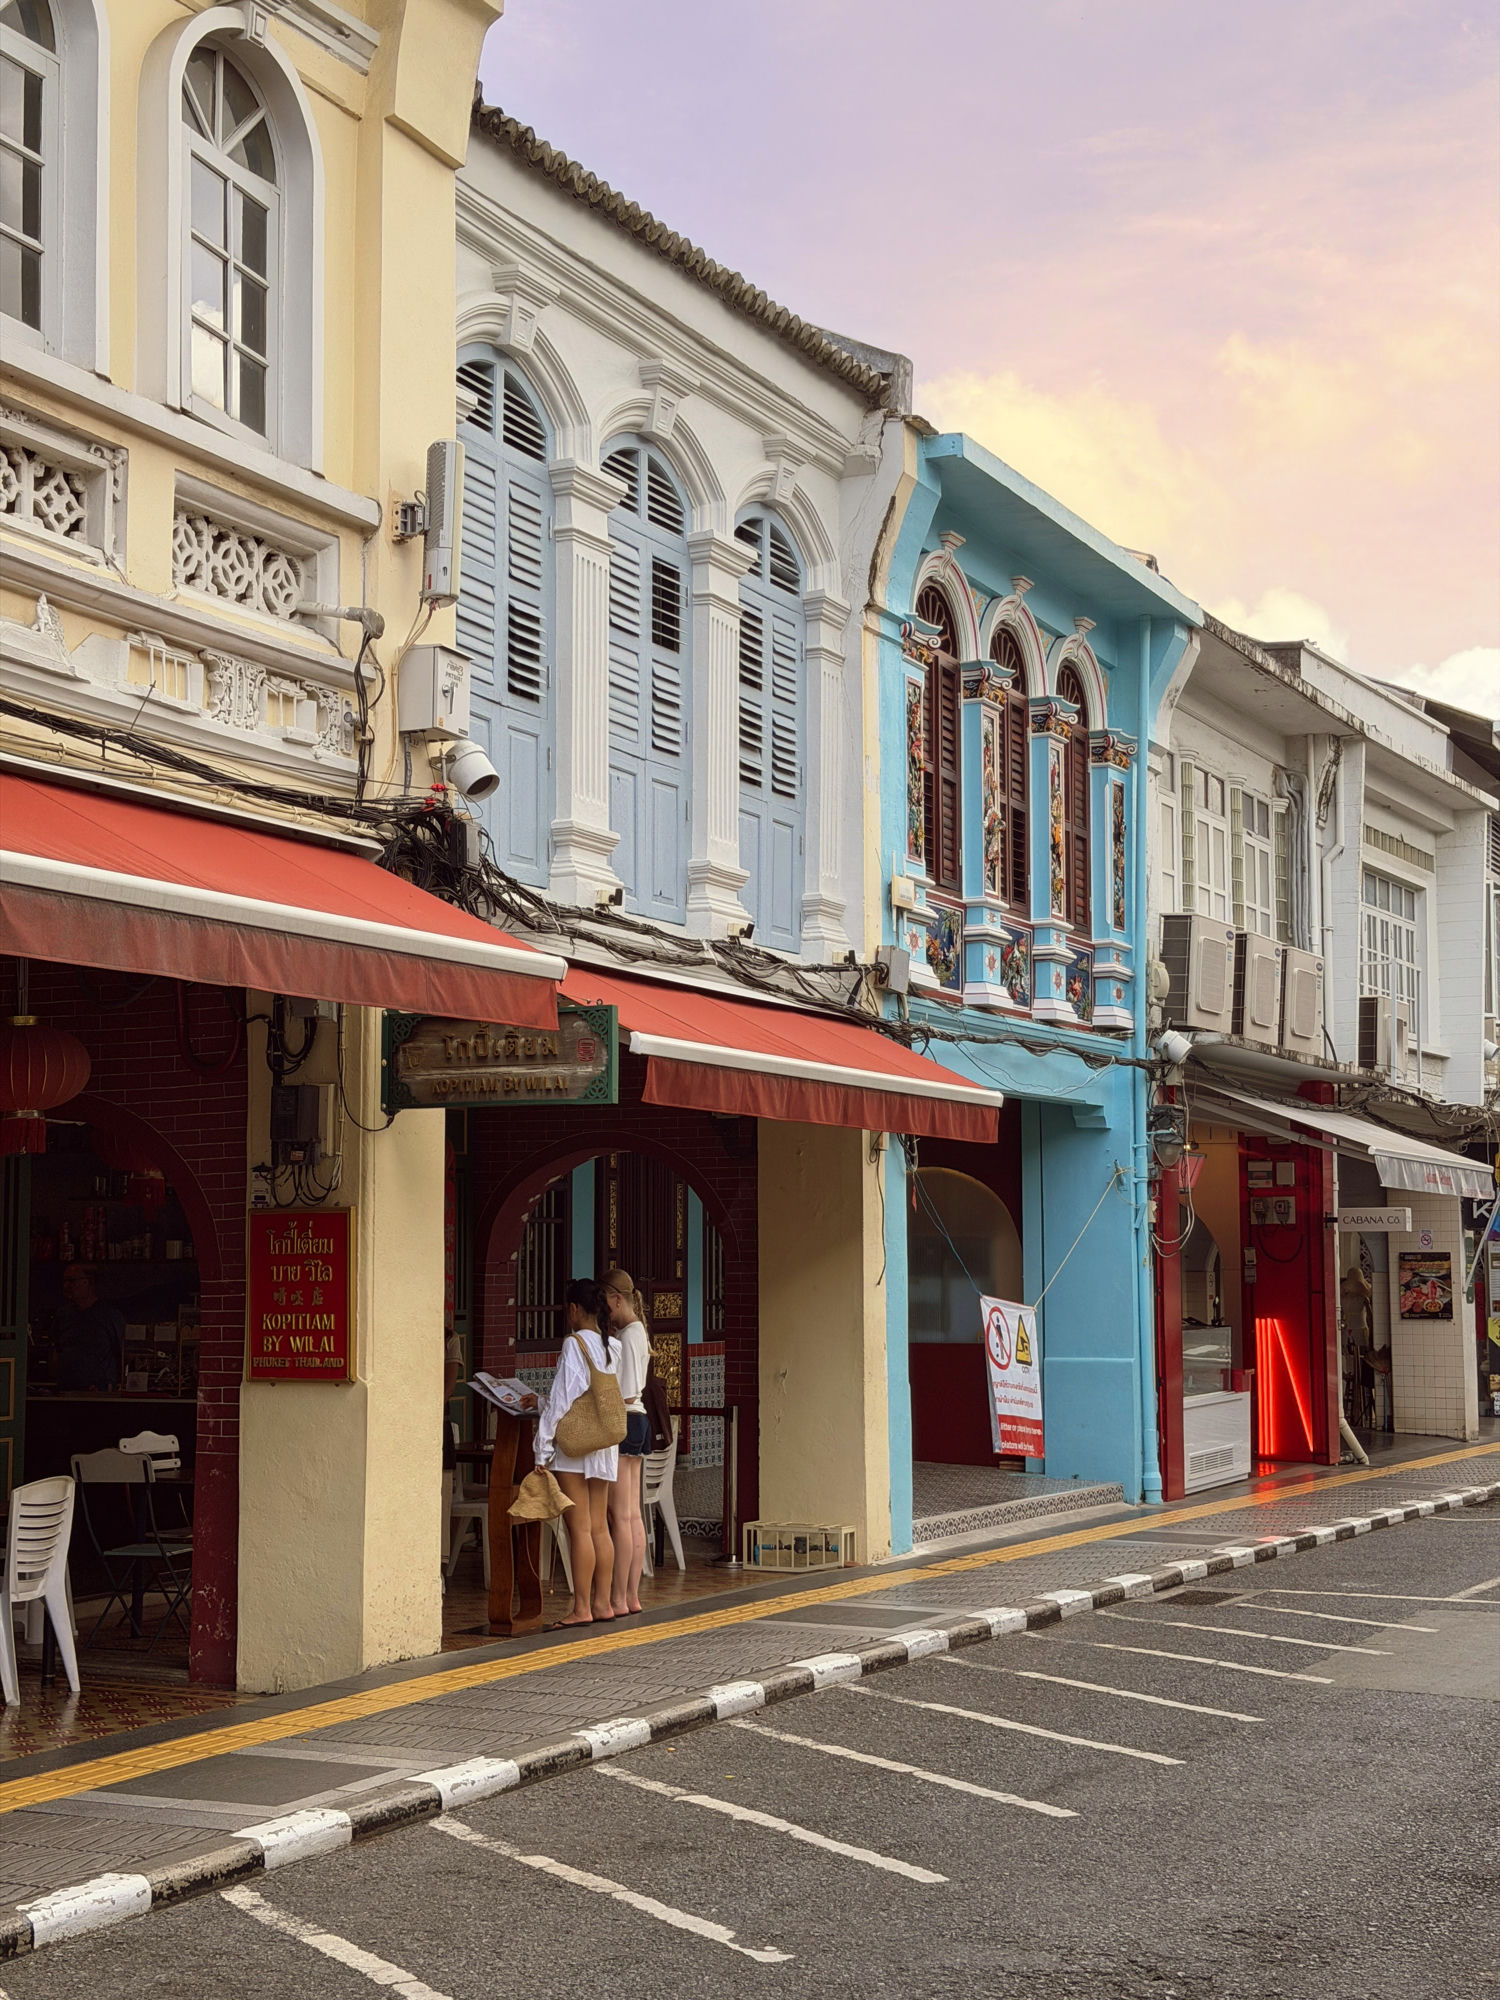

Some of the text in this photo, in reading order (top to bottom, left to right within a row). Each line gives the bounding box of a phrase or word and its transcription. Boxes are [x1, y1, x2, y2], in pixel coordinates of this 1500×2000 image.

[431, 1074, 569, 1096] KOPITIAM BY WILAI
[1342, 1215, 1384, 1225] CABANA
[265, 1220, 334, 1255] โกปี้เตี่ยม
[270, 1258, 333, 1282] บาย วิไล
[262, 1313, 335, 1331] KOPITIAM
[263, 1335, 335, 1353] BY WILAI
[252, 1356, 345, 1369] PHUKET THAILAND
